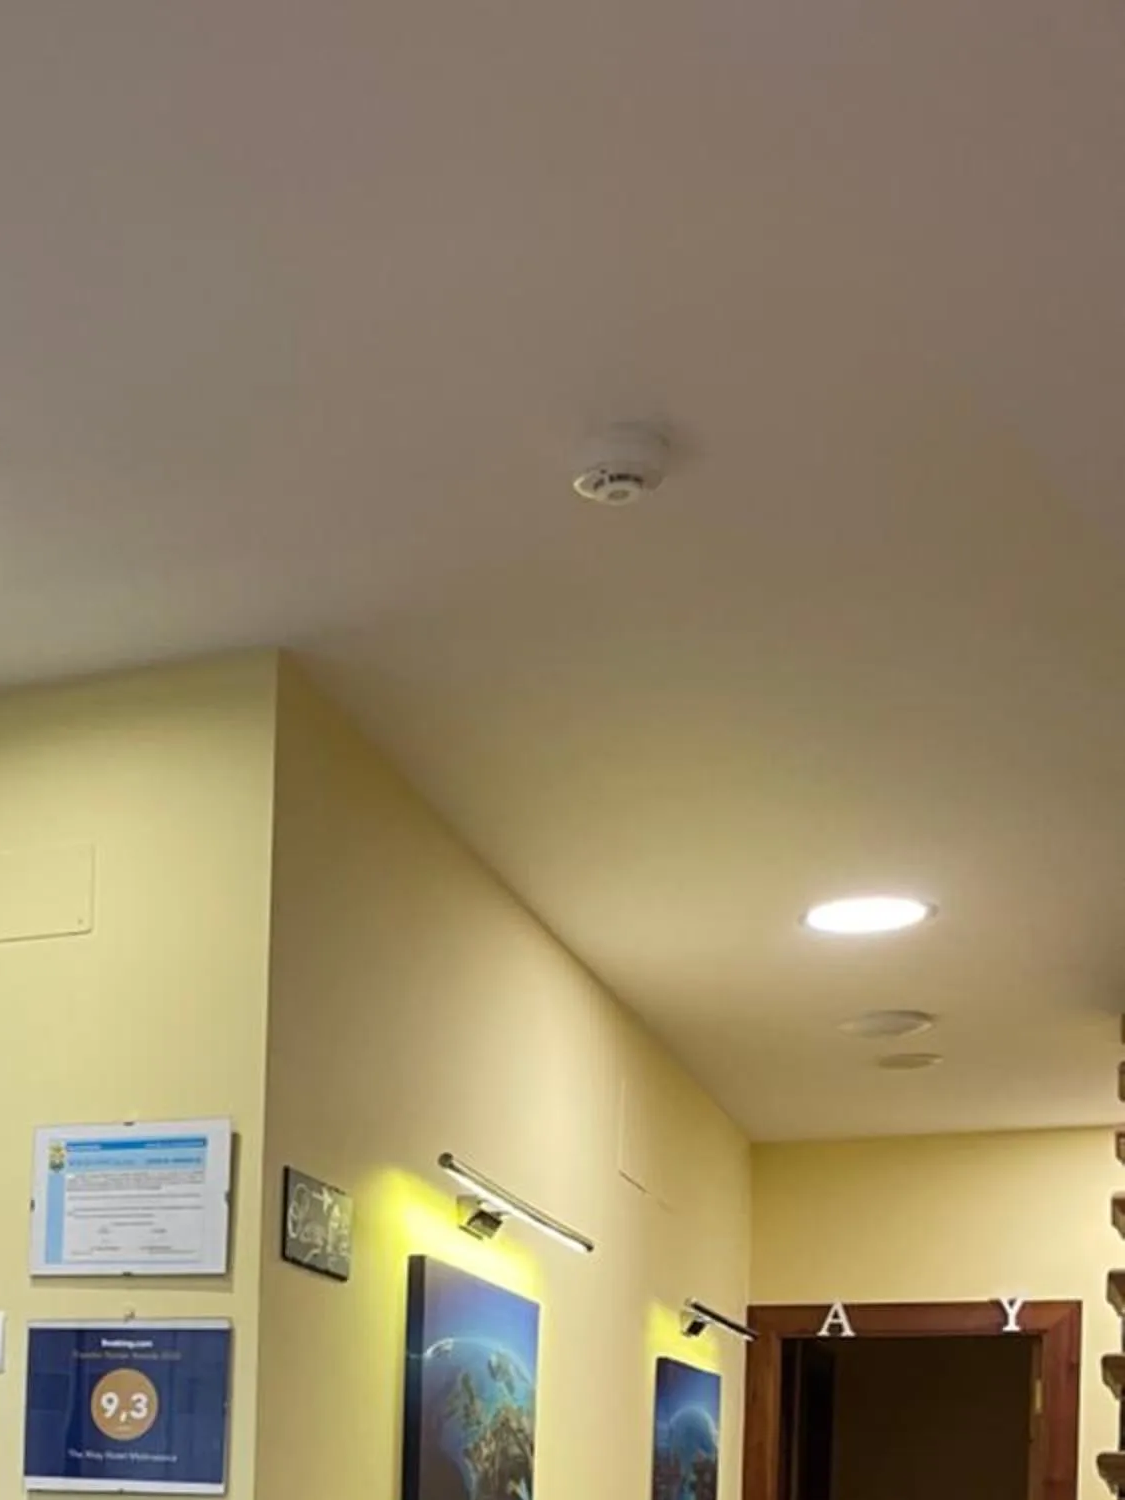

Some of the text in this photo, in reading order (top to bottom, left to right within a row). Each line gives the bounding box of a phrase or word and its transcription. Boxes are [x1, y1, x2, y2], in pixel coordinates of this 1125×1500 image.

[816, 1294, 1026, 1337] A Y
[100, 1391, 148, 1422] 9,3
